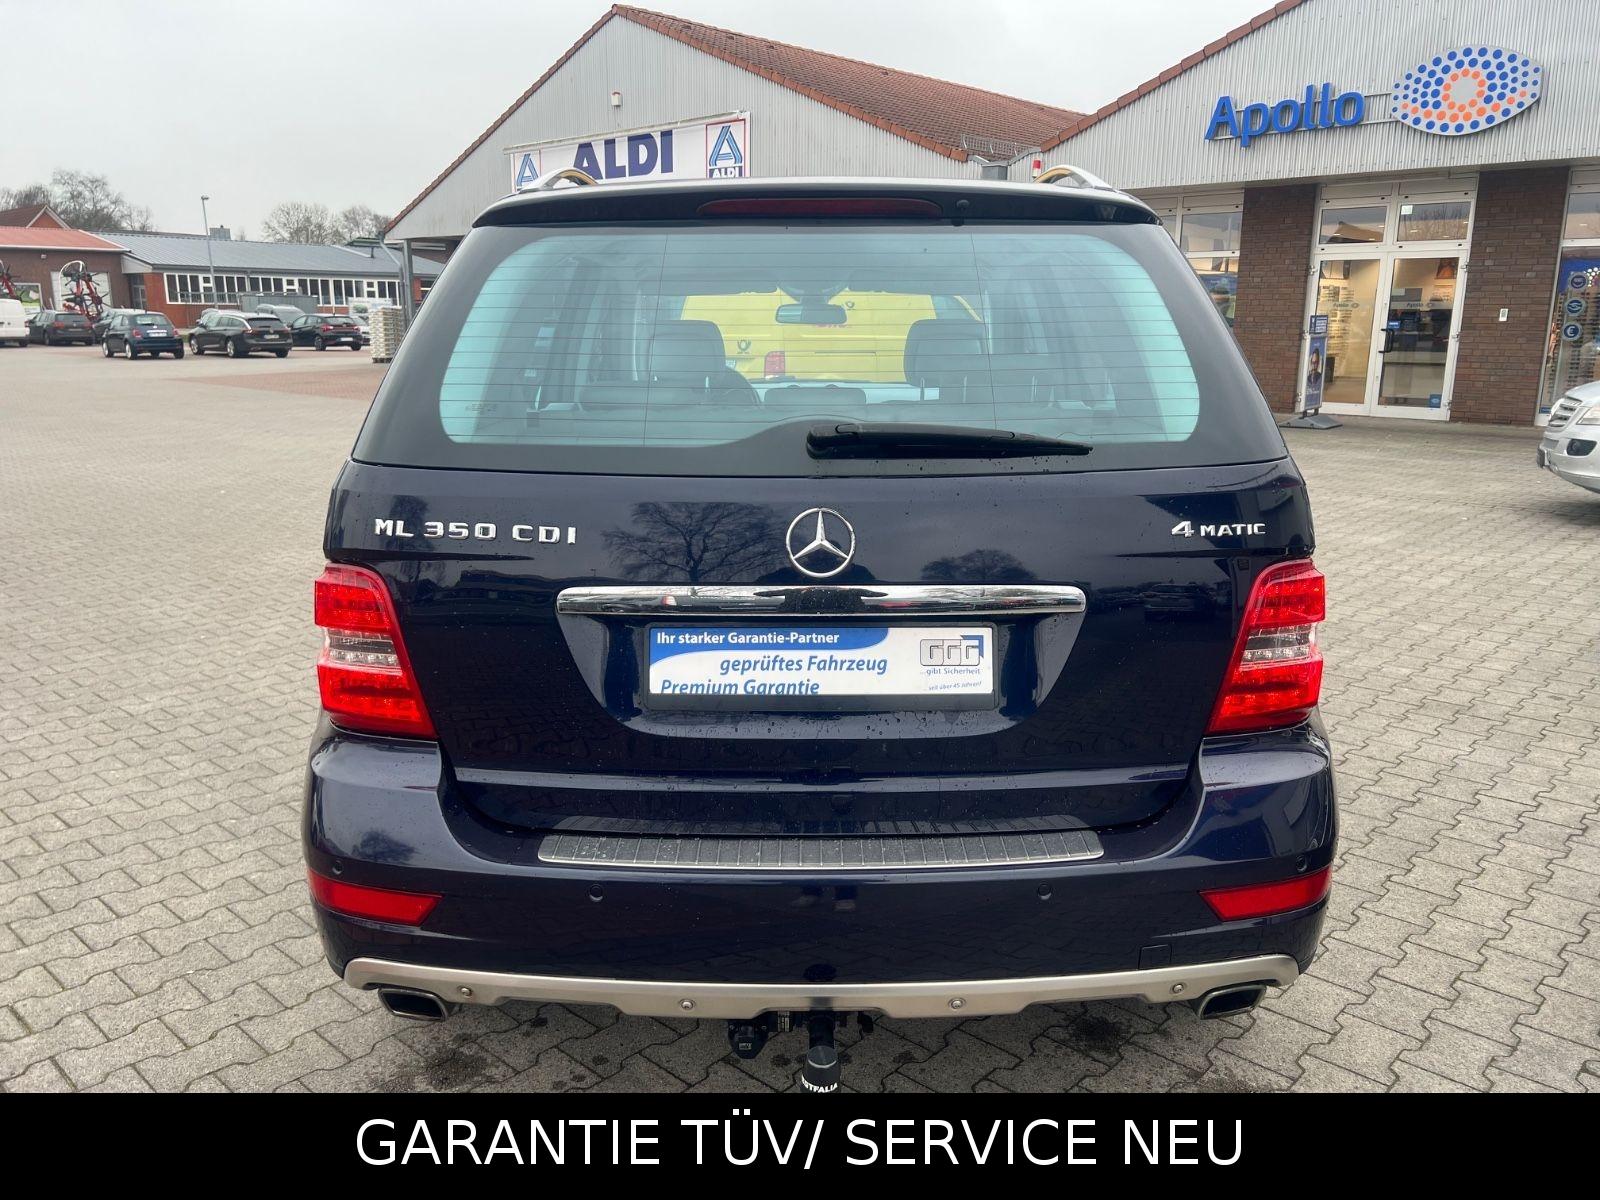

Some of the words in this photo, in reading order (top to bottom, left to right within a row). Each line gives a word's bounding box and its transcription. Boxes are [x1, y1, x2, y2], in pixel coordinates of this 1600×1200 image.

[1204, 82, 1366, 148] Apollo
[573, 130, 674, 180] ALDI
[712, 167, 739, 178] ALDI
[375, 518, 414, 537] ML
[423, 521, 498, 540] 350
[512, 524, 577, 545] CDI
[657, 632, 676, 644] Ihr
[678, 632, 726, 644] starker
[727, 632, 840, 644] Garantie-Partner
[719, 655, 803, 675] geprüftes
[807, 655, 888, 675] Fahrzeug
[943, 667, 981, 675] Sicherheit
[660, 679, 739, 695] Premium
[743, 679, 820, 695] Garantie
